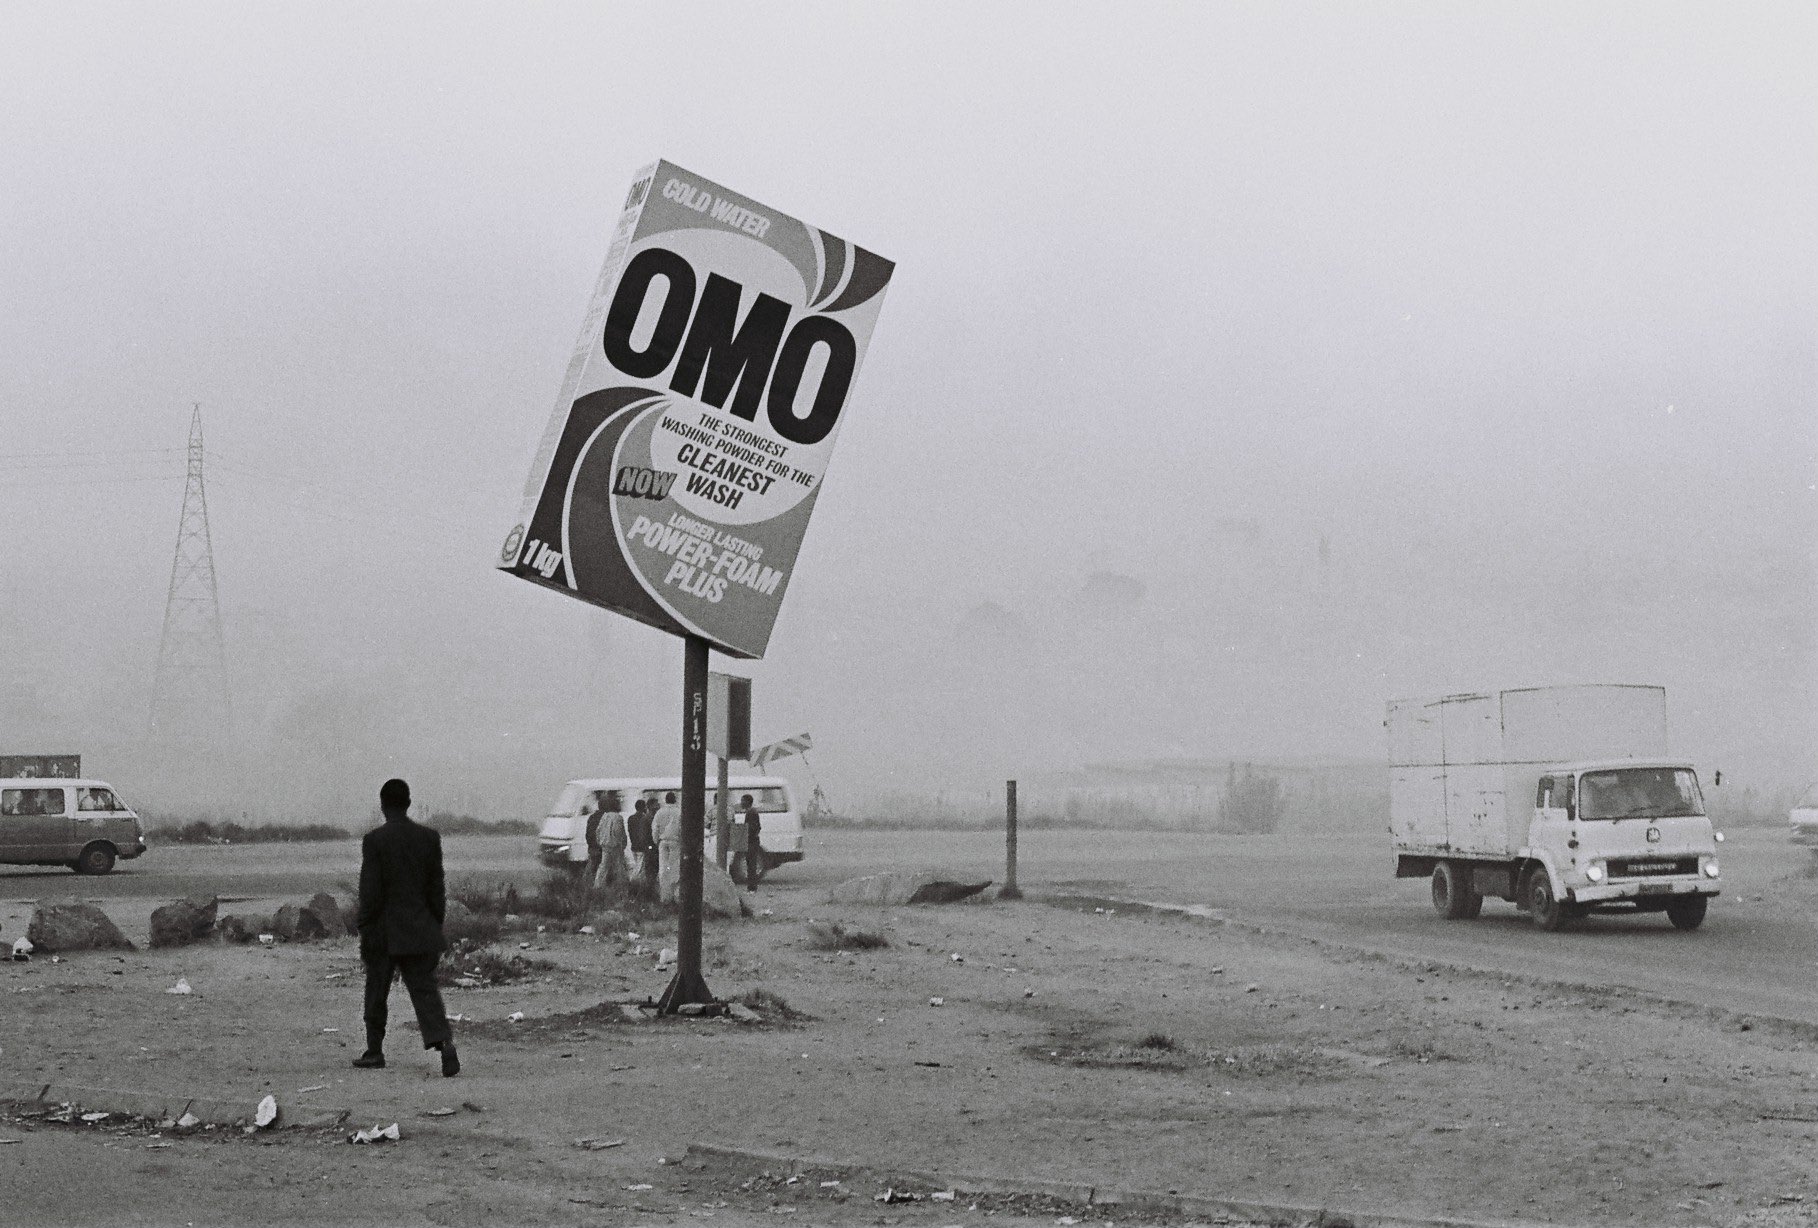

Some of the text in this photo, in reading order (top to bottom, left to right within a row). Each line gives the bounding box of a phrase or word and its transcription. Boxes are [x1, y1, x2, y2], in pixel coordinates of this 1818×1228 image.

[662, 178, 771, 238] COLD WATER
[603, 247, 857, 445] OMO
[661, 416, 816, 488] WASHING POWDER FOR THE
[699, 413, 789, 459] THE STRONGEST
[612, 465, 678, 501] NOW
[677, 443, 776, 496] CLEANEST
[685, 472, 744, 510] WASH
[522, 538, 541, 566] 1
[626, 514, 784, 596] POWER-FOAM
[667, 511, 764, 561] LONGER LASTING
[531, 542, 563, 579] kg
[663, 559, 729, 603] PLUS
